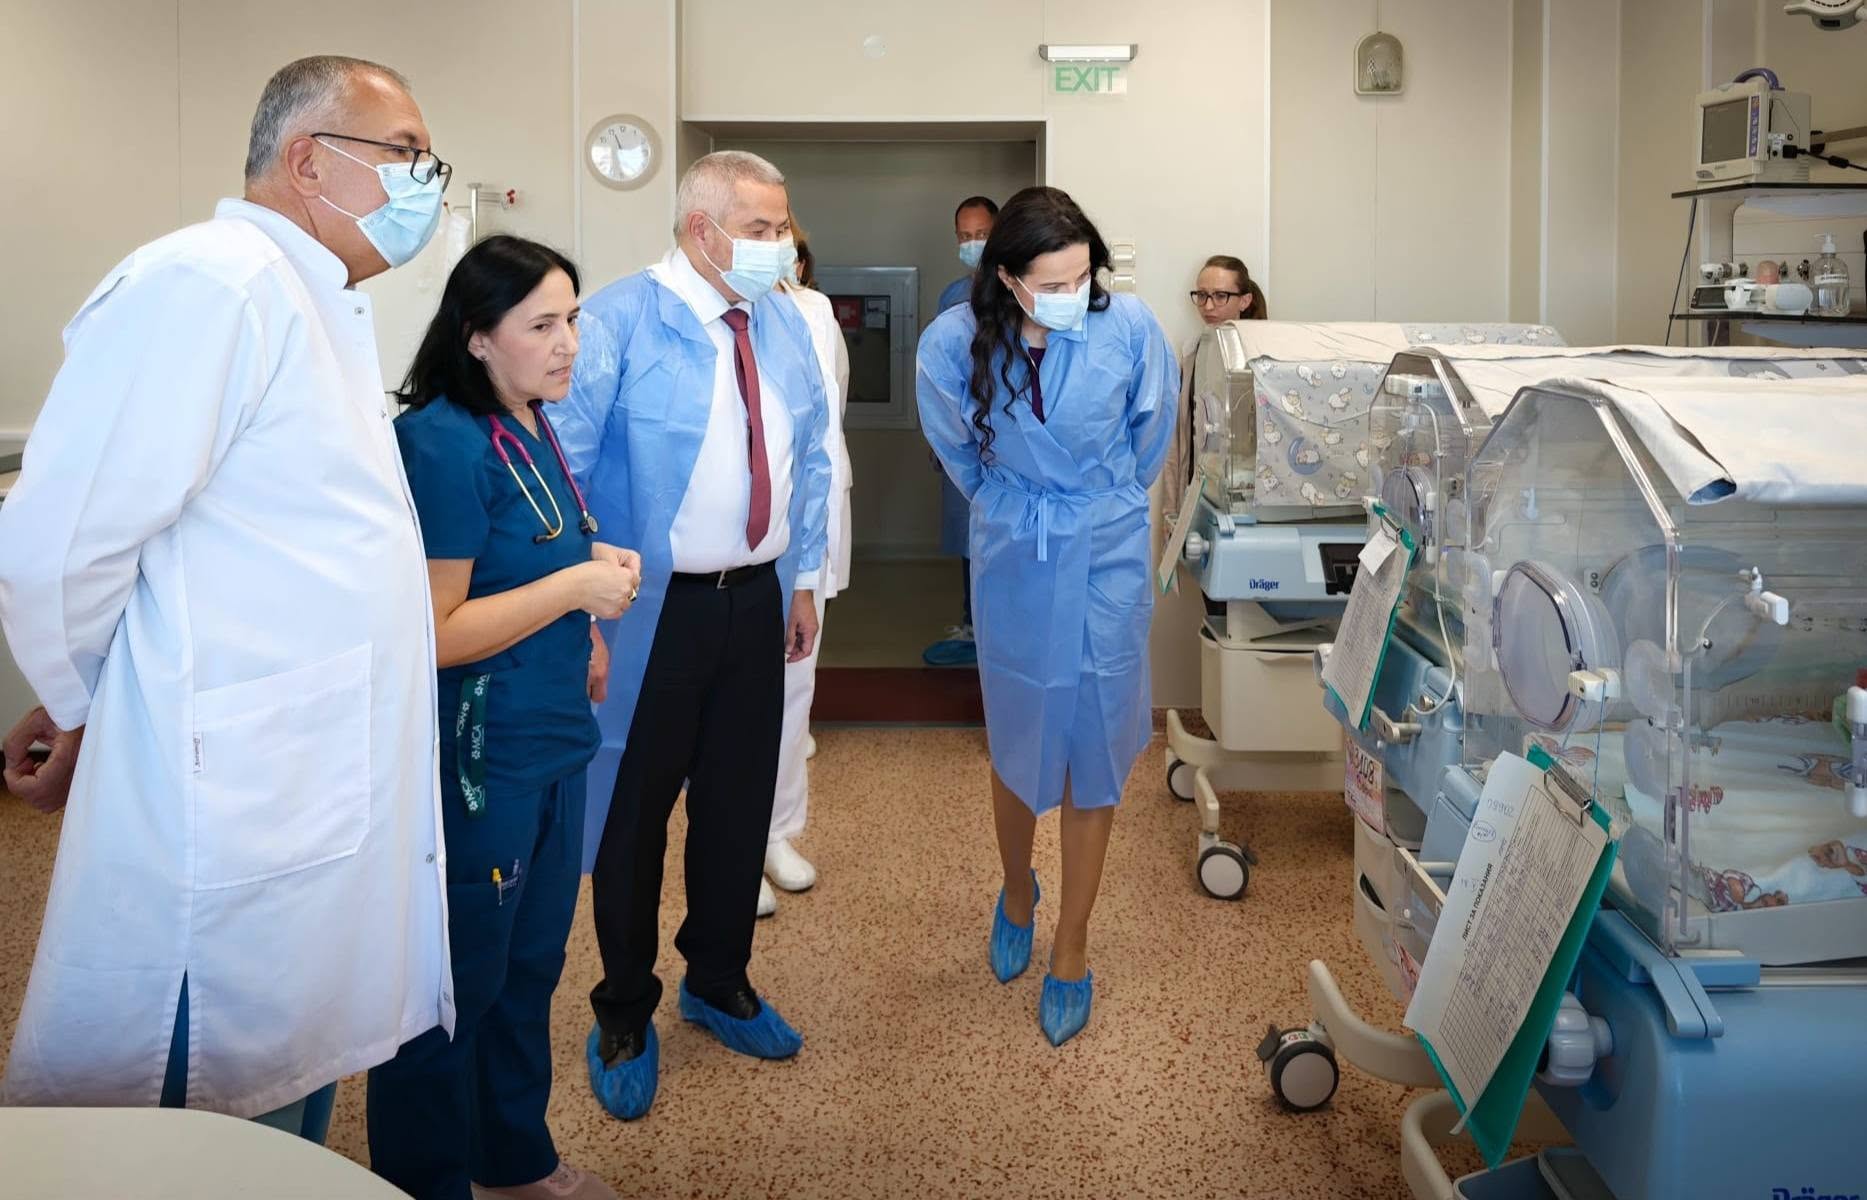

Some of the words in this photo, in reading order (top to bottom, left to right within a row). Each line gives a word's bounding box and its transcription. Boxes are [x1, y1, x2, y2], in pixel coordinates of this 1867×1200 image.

[1055, 66, 1120, 92] EXIT
[1249, 578, 1279, 591] Dräger
[471, 724, 482, 748] MCA
[1462, 920, 1473, 941] ЛИСТ
[1474, 863, 1493, 909] ПОКАЗАНИЯ
